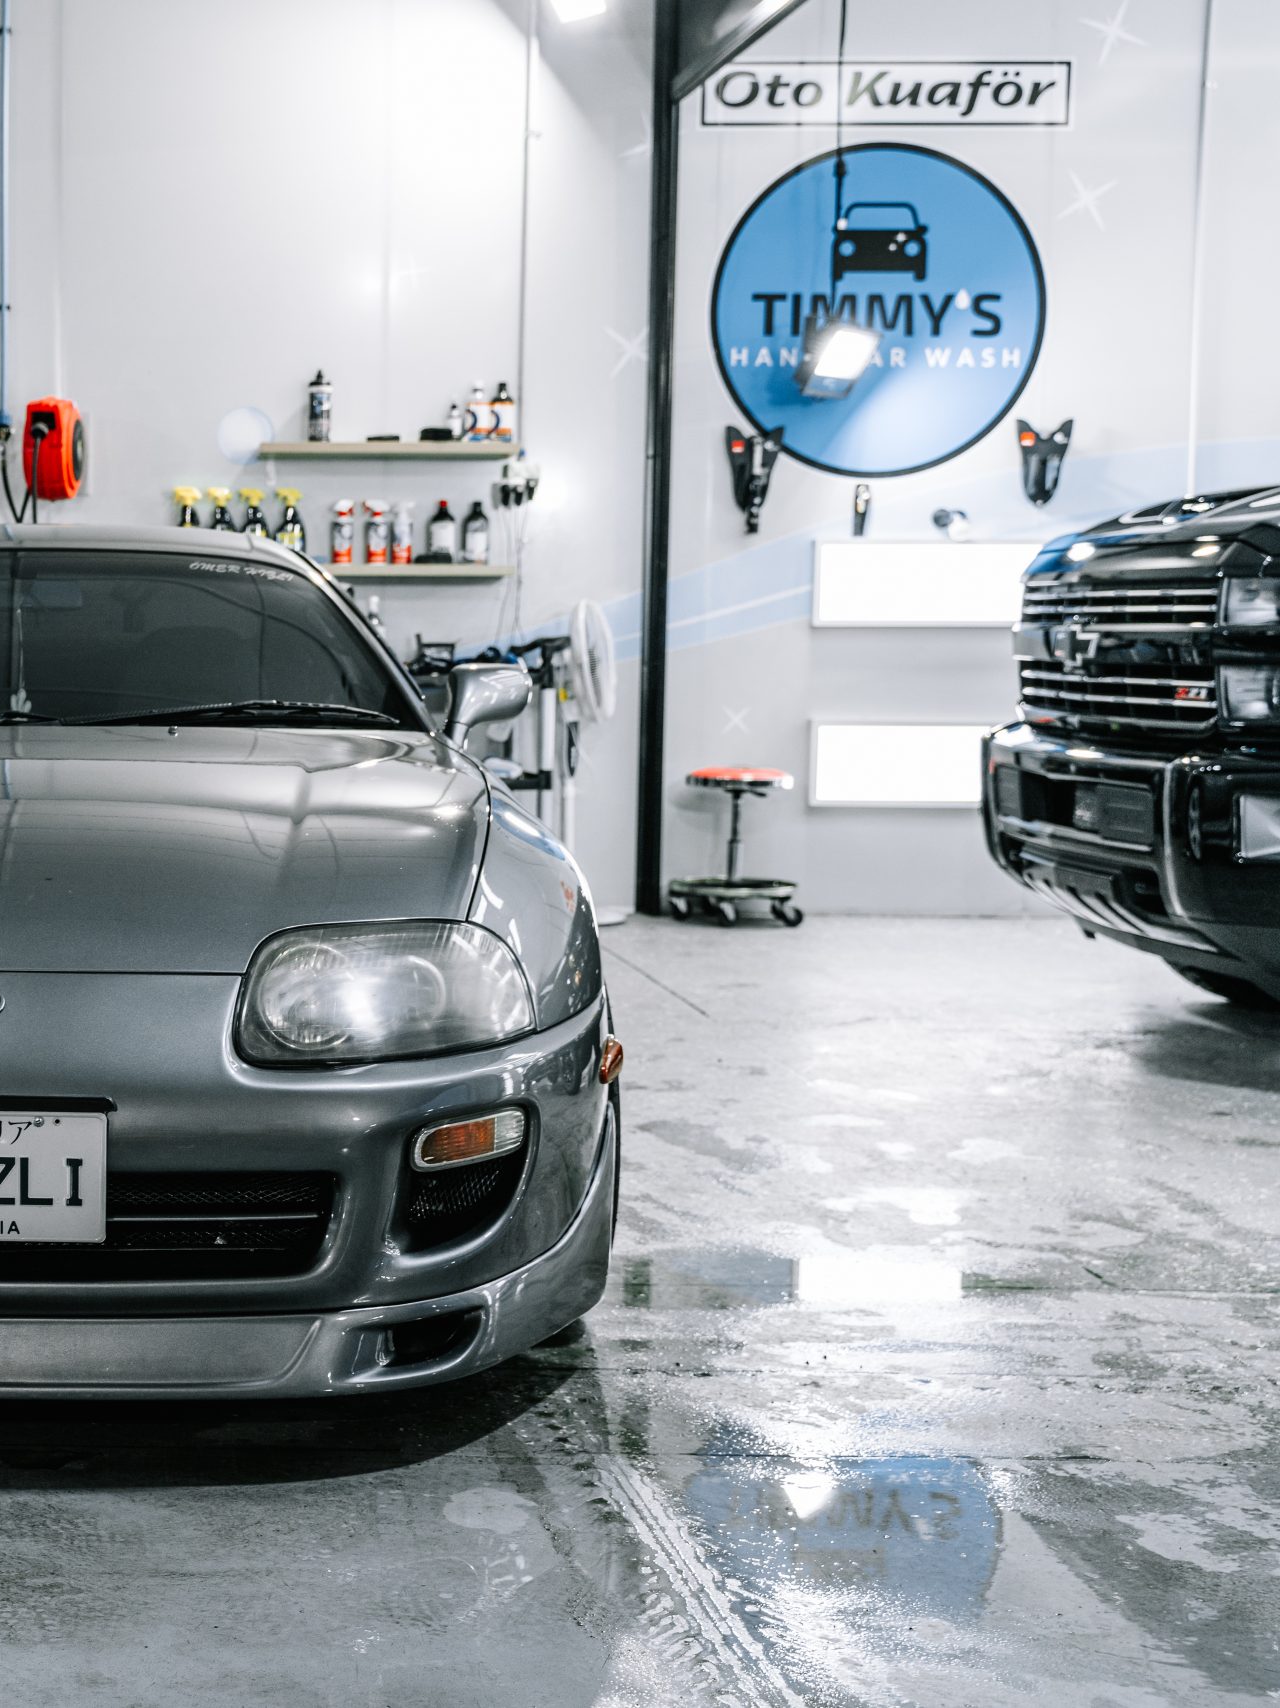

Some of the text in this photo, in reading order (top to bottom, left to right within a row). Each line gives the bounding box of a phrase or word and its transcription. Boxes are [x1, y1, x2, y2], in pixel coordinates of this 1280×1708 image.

[715, 70, 1055, 116] Oto Kuaför
[752, 293, 1003, 336] TIMMY'S
[730, 346, 808, 367] HAN
[924, 346, 1021, 368] WASH
